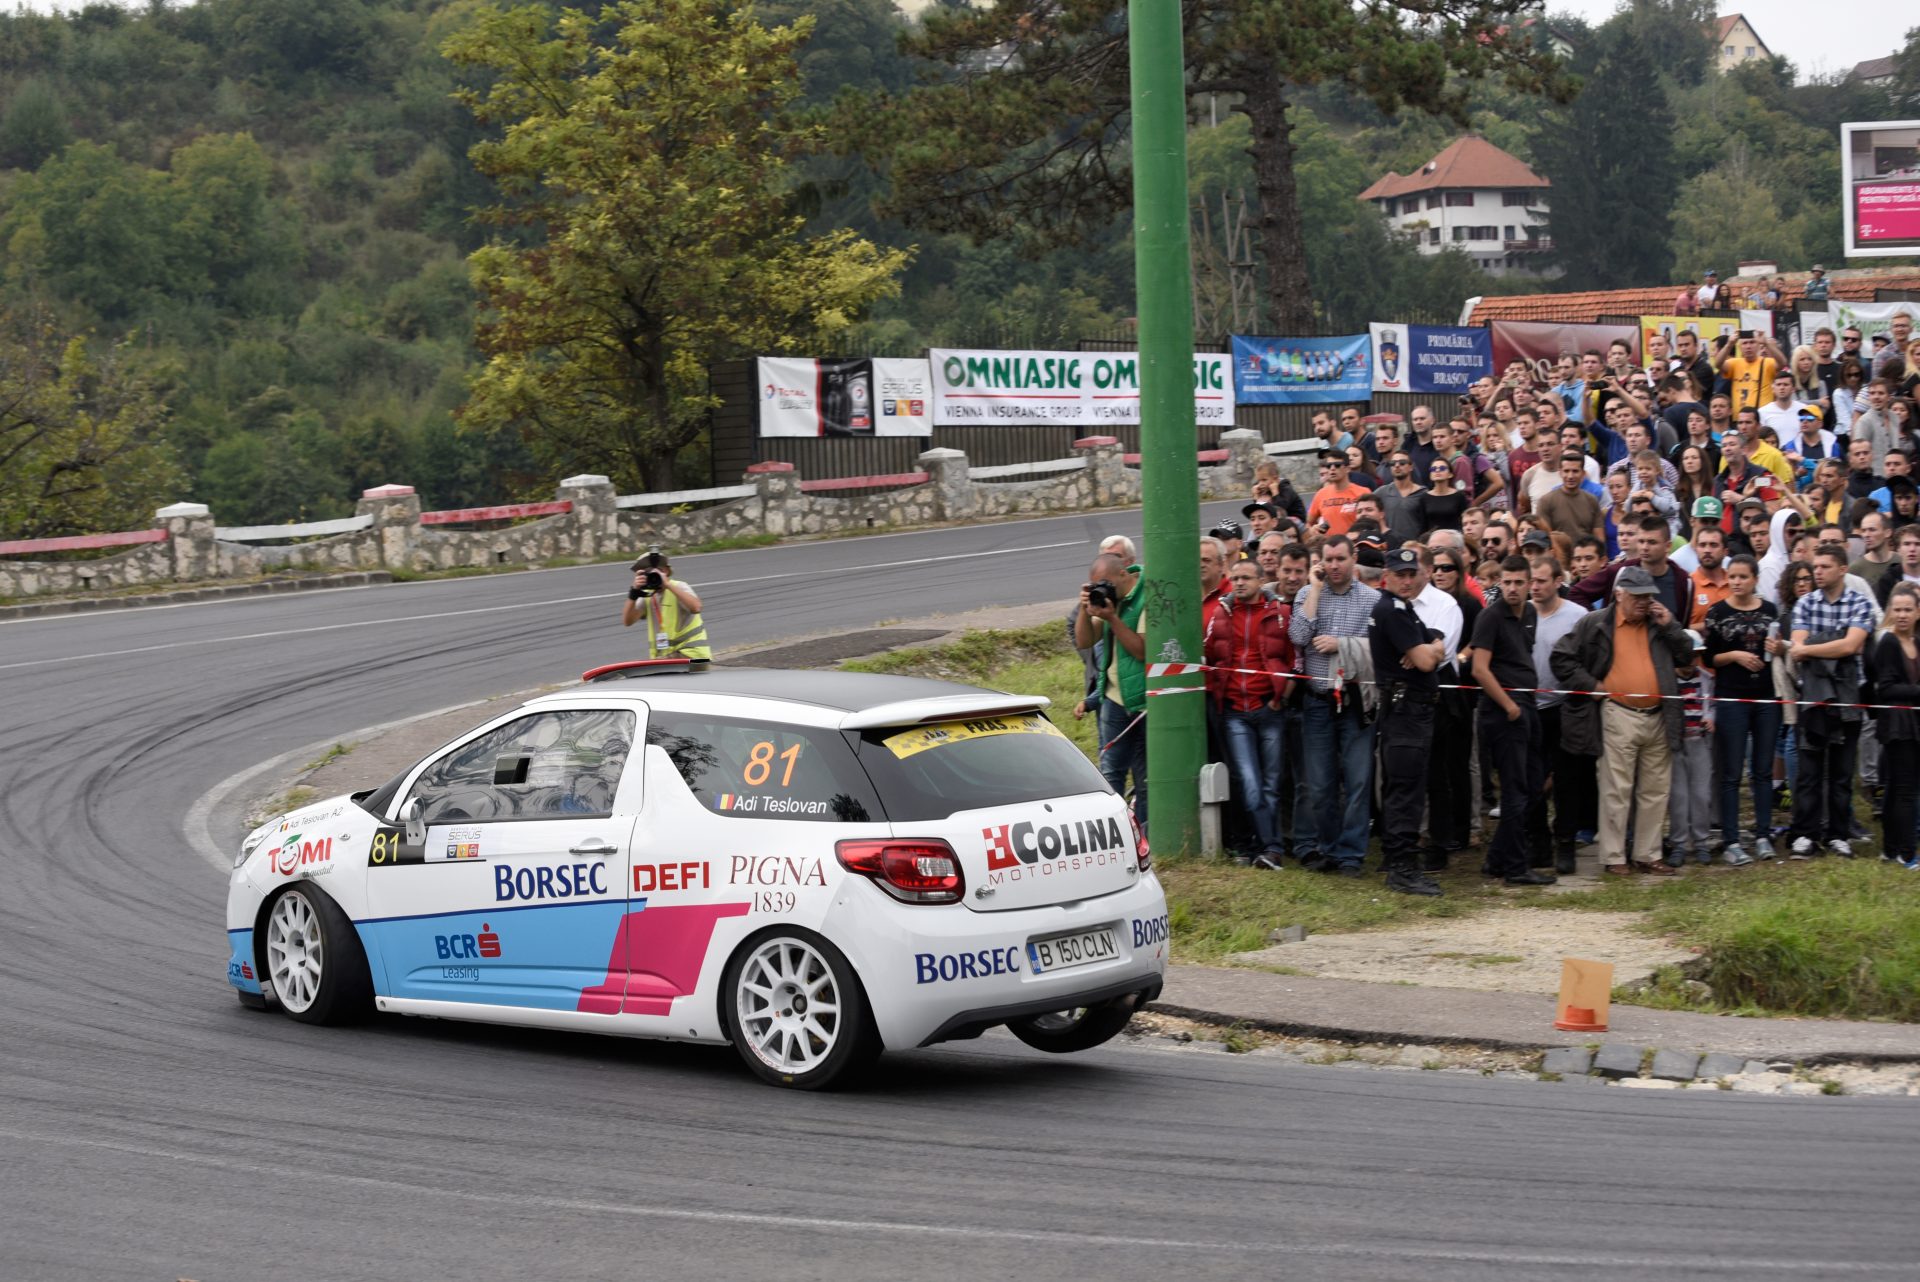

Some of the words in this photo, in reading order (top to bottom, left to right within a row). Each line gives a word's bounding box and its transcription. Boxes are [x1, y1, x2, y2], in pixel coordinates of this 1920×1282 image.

[1427, 334, 1473, 348] PRIMĂRIA
[943, 356, 1082, 389] OMNIASIG
[945, 406, 983, 417] VIENNA
[988, 406, 1047, 418] INSURANCE
[1050, 406, 1083, 418] GROUP
[1093, 406, 1131, 418] VIENNA
[743, 741, 801, 787] 81
[733, 795, 758, 811] Adi
[763, 796, 827, 814] Teslovan
[372, 832, 400, 863] 81
[448, 831, 482, 840] SERUS
[1011, 817, 1125, 864] COLINA
[268, 837, 332, 875] TOMI
[728, 855, 828, 887] PIGNA
[989, 851, 1127, 886] MOTORSPORT
[494, 862, 608, 901] BORSEC
[633, 861, 710, 892] DEFI
[754, 891, 796, 913] 1839
[435, 934, 479, 959] BCR
[1132, 914, 1169, 949] BORSE
[915, 946, 1021, 984] BORSEC
[1038, 943, 1053, 967] B
[1056, 938, 1082, 963] 150
[1083, 932, 1115, 958] CLN
[442, 966, 480, 981] Leasing
